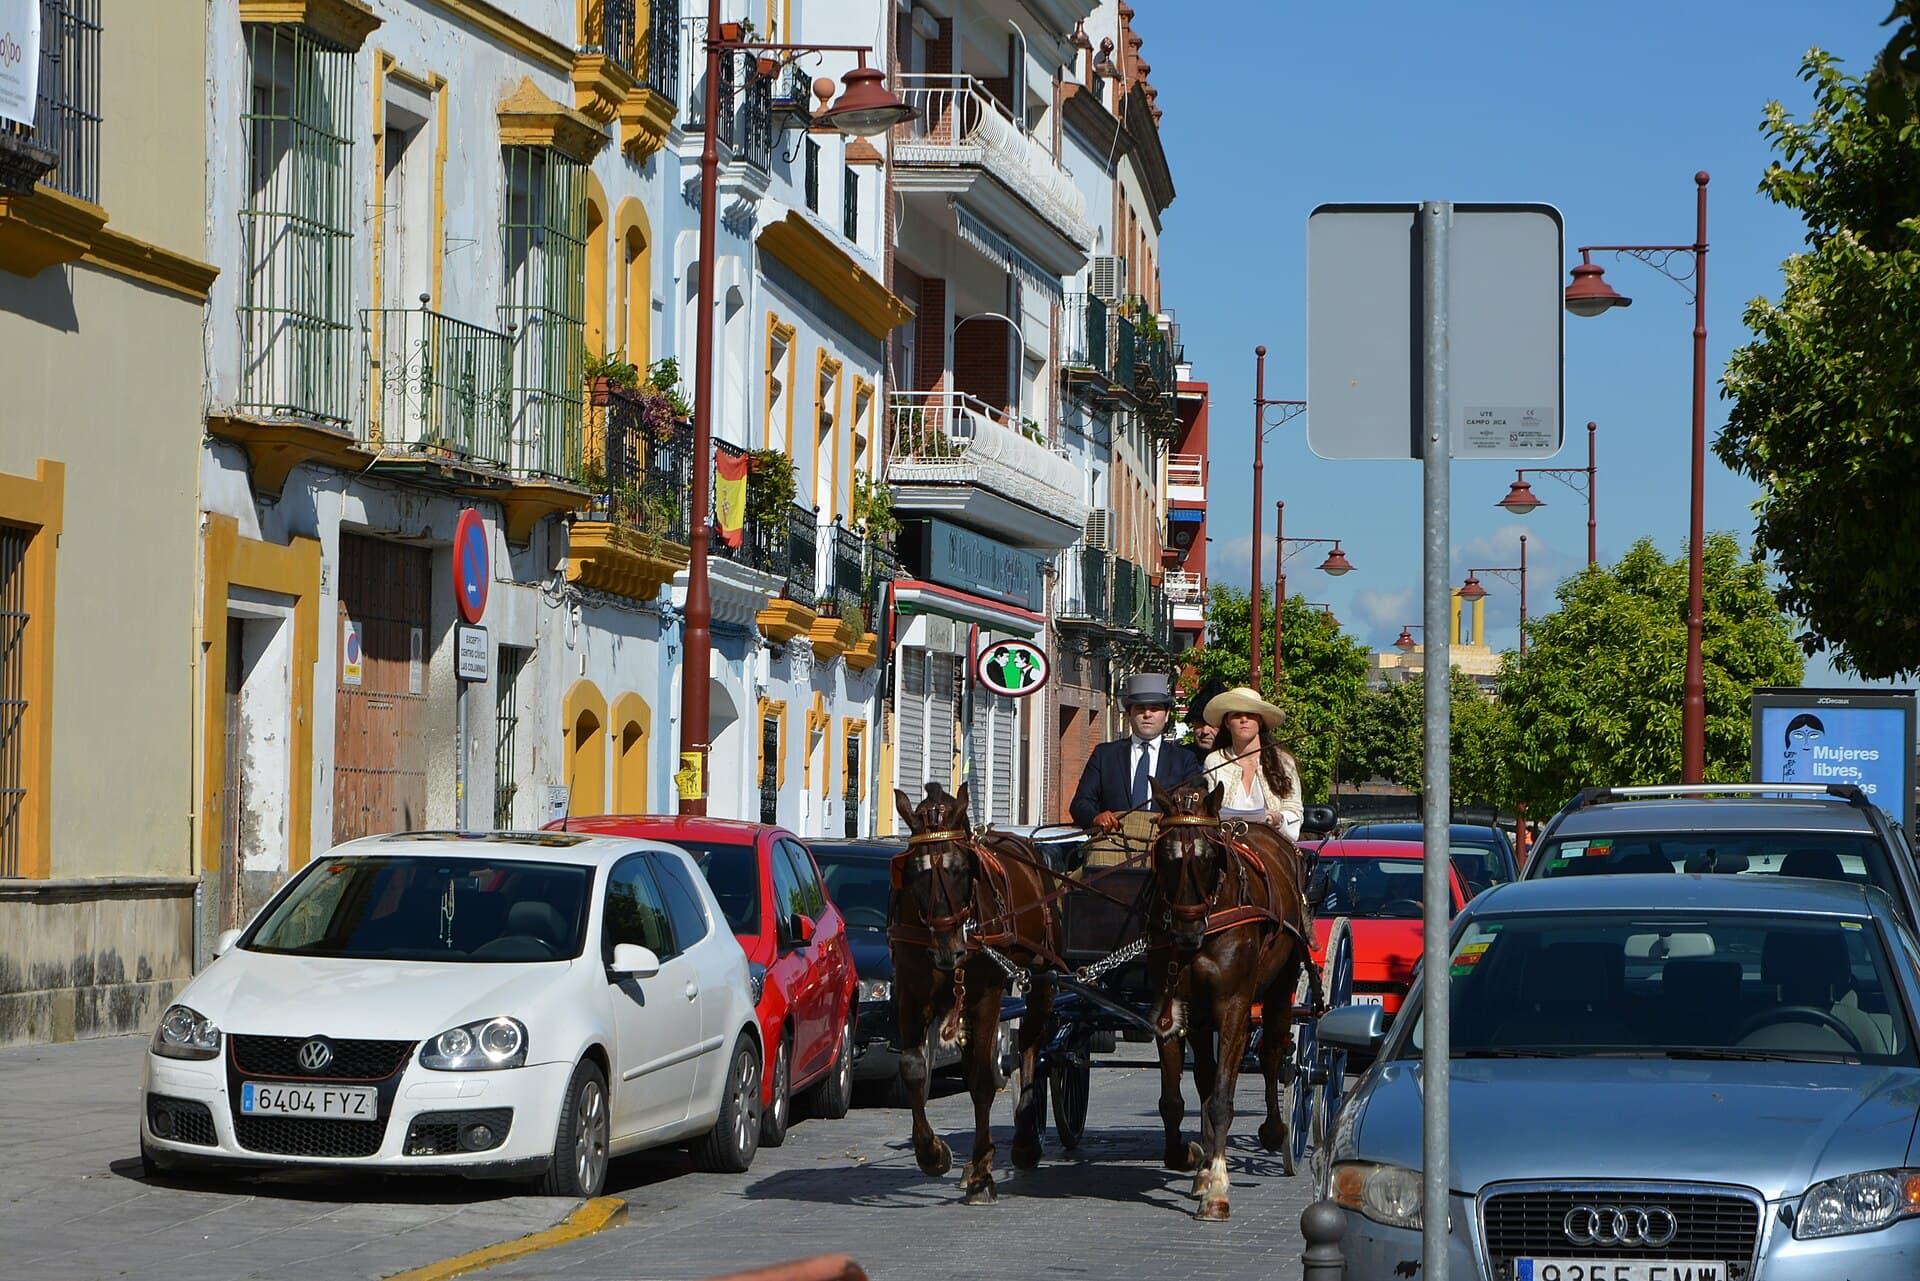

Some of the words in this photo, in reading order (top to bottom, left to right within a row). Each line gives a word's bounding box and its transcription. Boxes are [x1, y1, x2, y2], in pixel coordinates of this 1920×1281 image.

[1813, 745, 1880, 762] Mujeres
[1813, 762, 1863, 779] libres,
[259, 1088, 316, 1113] 6404
[323, 1092, 367, 1114] FYZ
